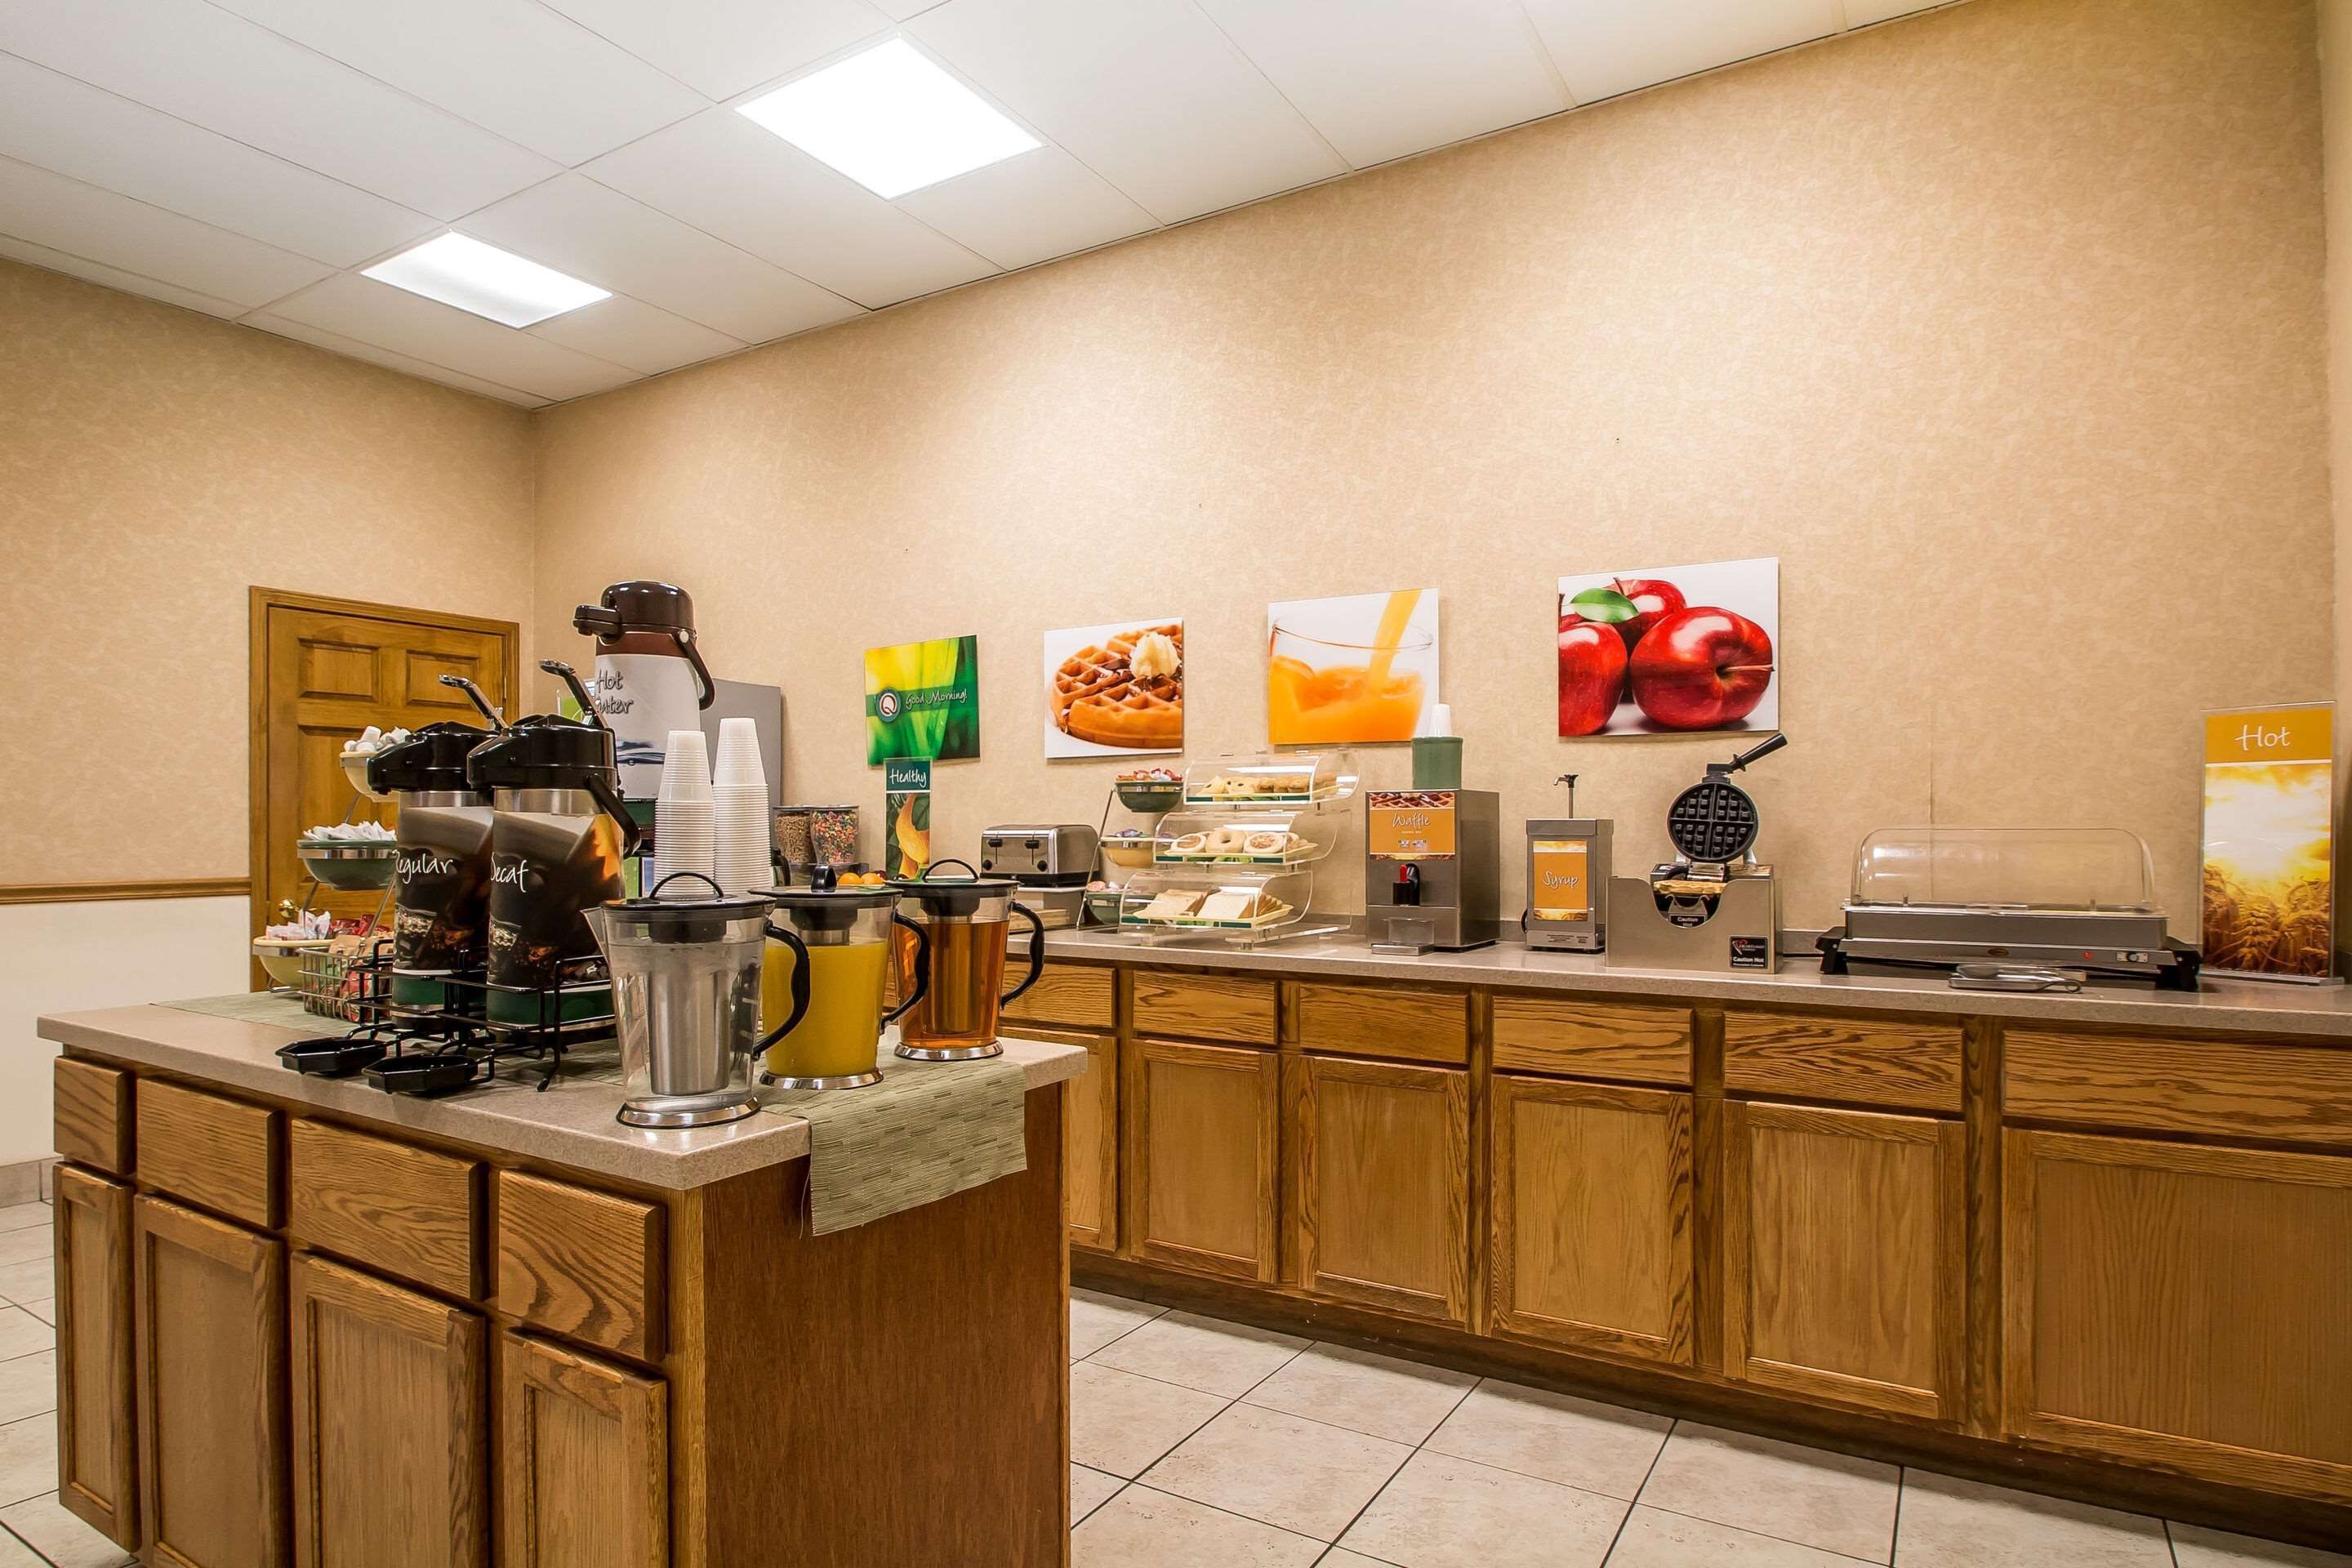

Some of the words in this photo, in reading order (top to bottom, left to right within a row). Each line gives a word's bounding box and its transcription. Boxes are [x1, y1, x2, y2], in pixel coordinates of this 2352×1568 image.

[596, 669, 624, 693] Hot
[599, 695, 635, 714] ater
[906, 693, 925, 710] Good
[927, 688, 968, 704] Morning!
[2234, 724, 2292, 751] Hot
[889, 768, 928, 788] Healthy
[1392, 811, 1431, 829] Waffle
[1542, 870, 1579, 889] Syrup
